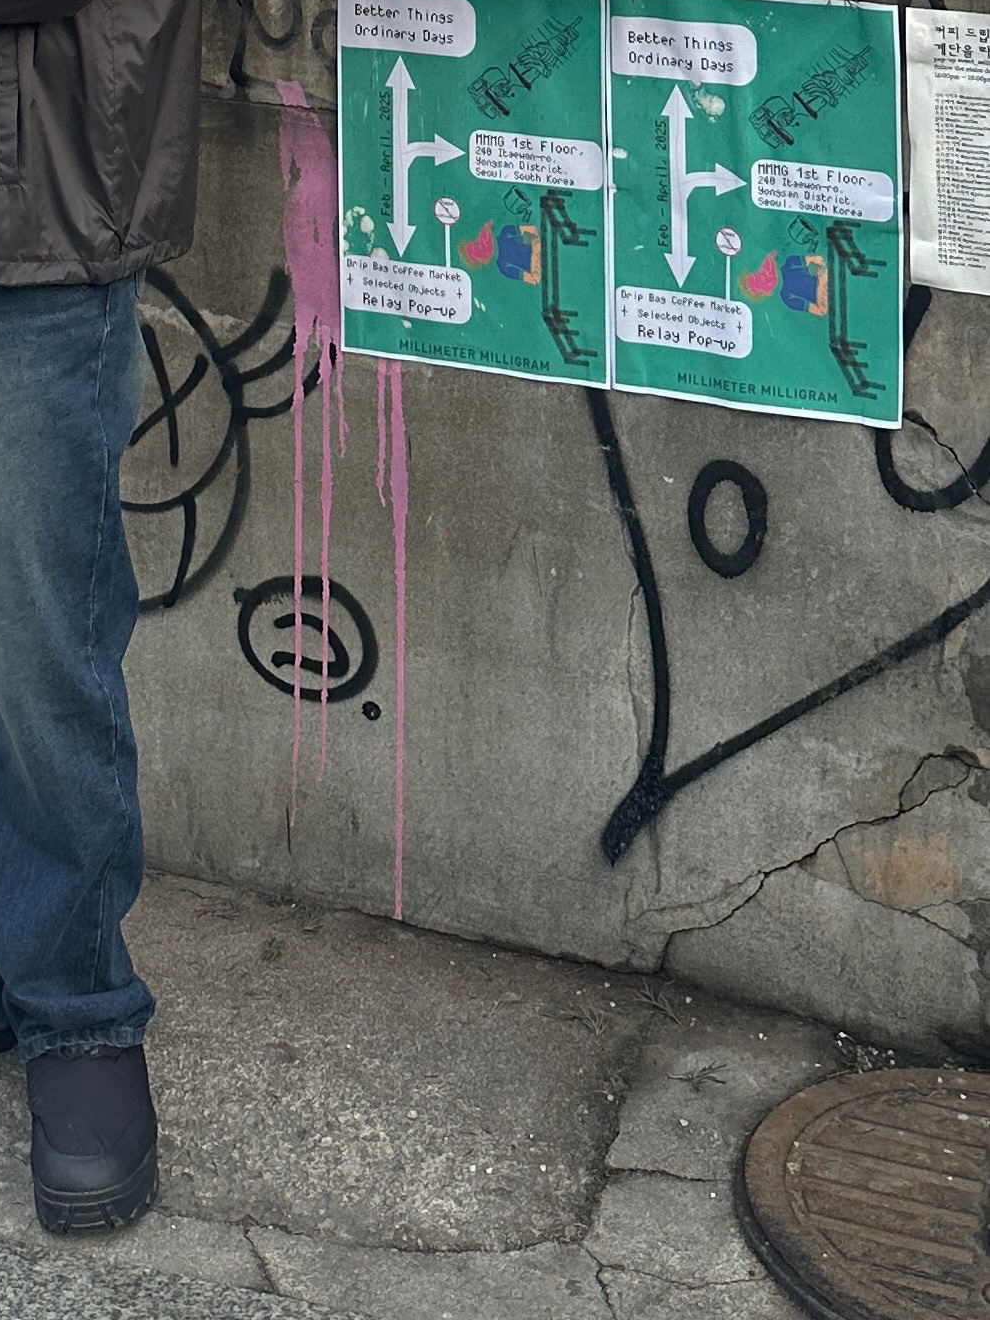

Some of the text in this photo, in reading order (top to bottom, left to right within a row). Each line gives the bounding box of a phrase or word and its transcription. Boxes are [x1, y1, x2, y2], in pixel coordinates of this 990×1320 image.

[354, 3, 454, 24] Better Things
[354, 24, 454, 45] Ordinary Days
[628, 30, 733, 52] Better Things
[628, 51, 734, 73] Ordinary Days
[379, 90, 391, 121] 2025
[475, 132, 505, 147] MMMG
[512, 137, 534, 151] 1st
[655, 119, 667, 151] 2025
[475, 157, 514, 170] Yongsan
[757, 162, 789, 177] MMMG
[796, 166, 819, 180] 1st
[514, 171, 541, 183] South
[546, 174, 574, 187] Korea
[380, 193, 391, 217] Feb
[757, 187, 799, 201] Yongsan
[798, 200, 827, 213] South
[832, 204, 863, 217] Korea
[657, 223, 669, 248] Feb
[346, 258, 461, 282] Drip Bag Coffee Market
[362, 276, 404, 292] Selected
[408, 283, 446, 297] Objects
[362, 292, 456, 319] Relay Pop-up
[620, 289, 742, 315] Drip Bag Coffee Market
[637, 308, 683, 324] Selected
[688, 314, 726, 330] Objects
[637, 324, 737, 352] Relay Pop-up
[399, 337, 550, 372] MILLIMETER MILLIGRAM
[676, 371, 838, 404] MILLIMETER MILLIGRAM
